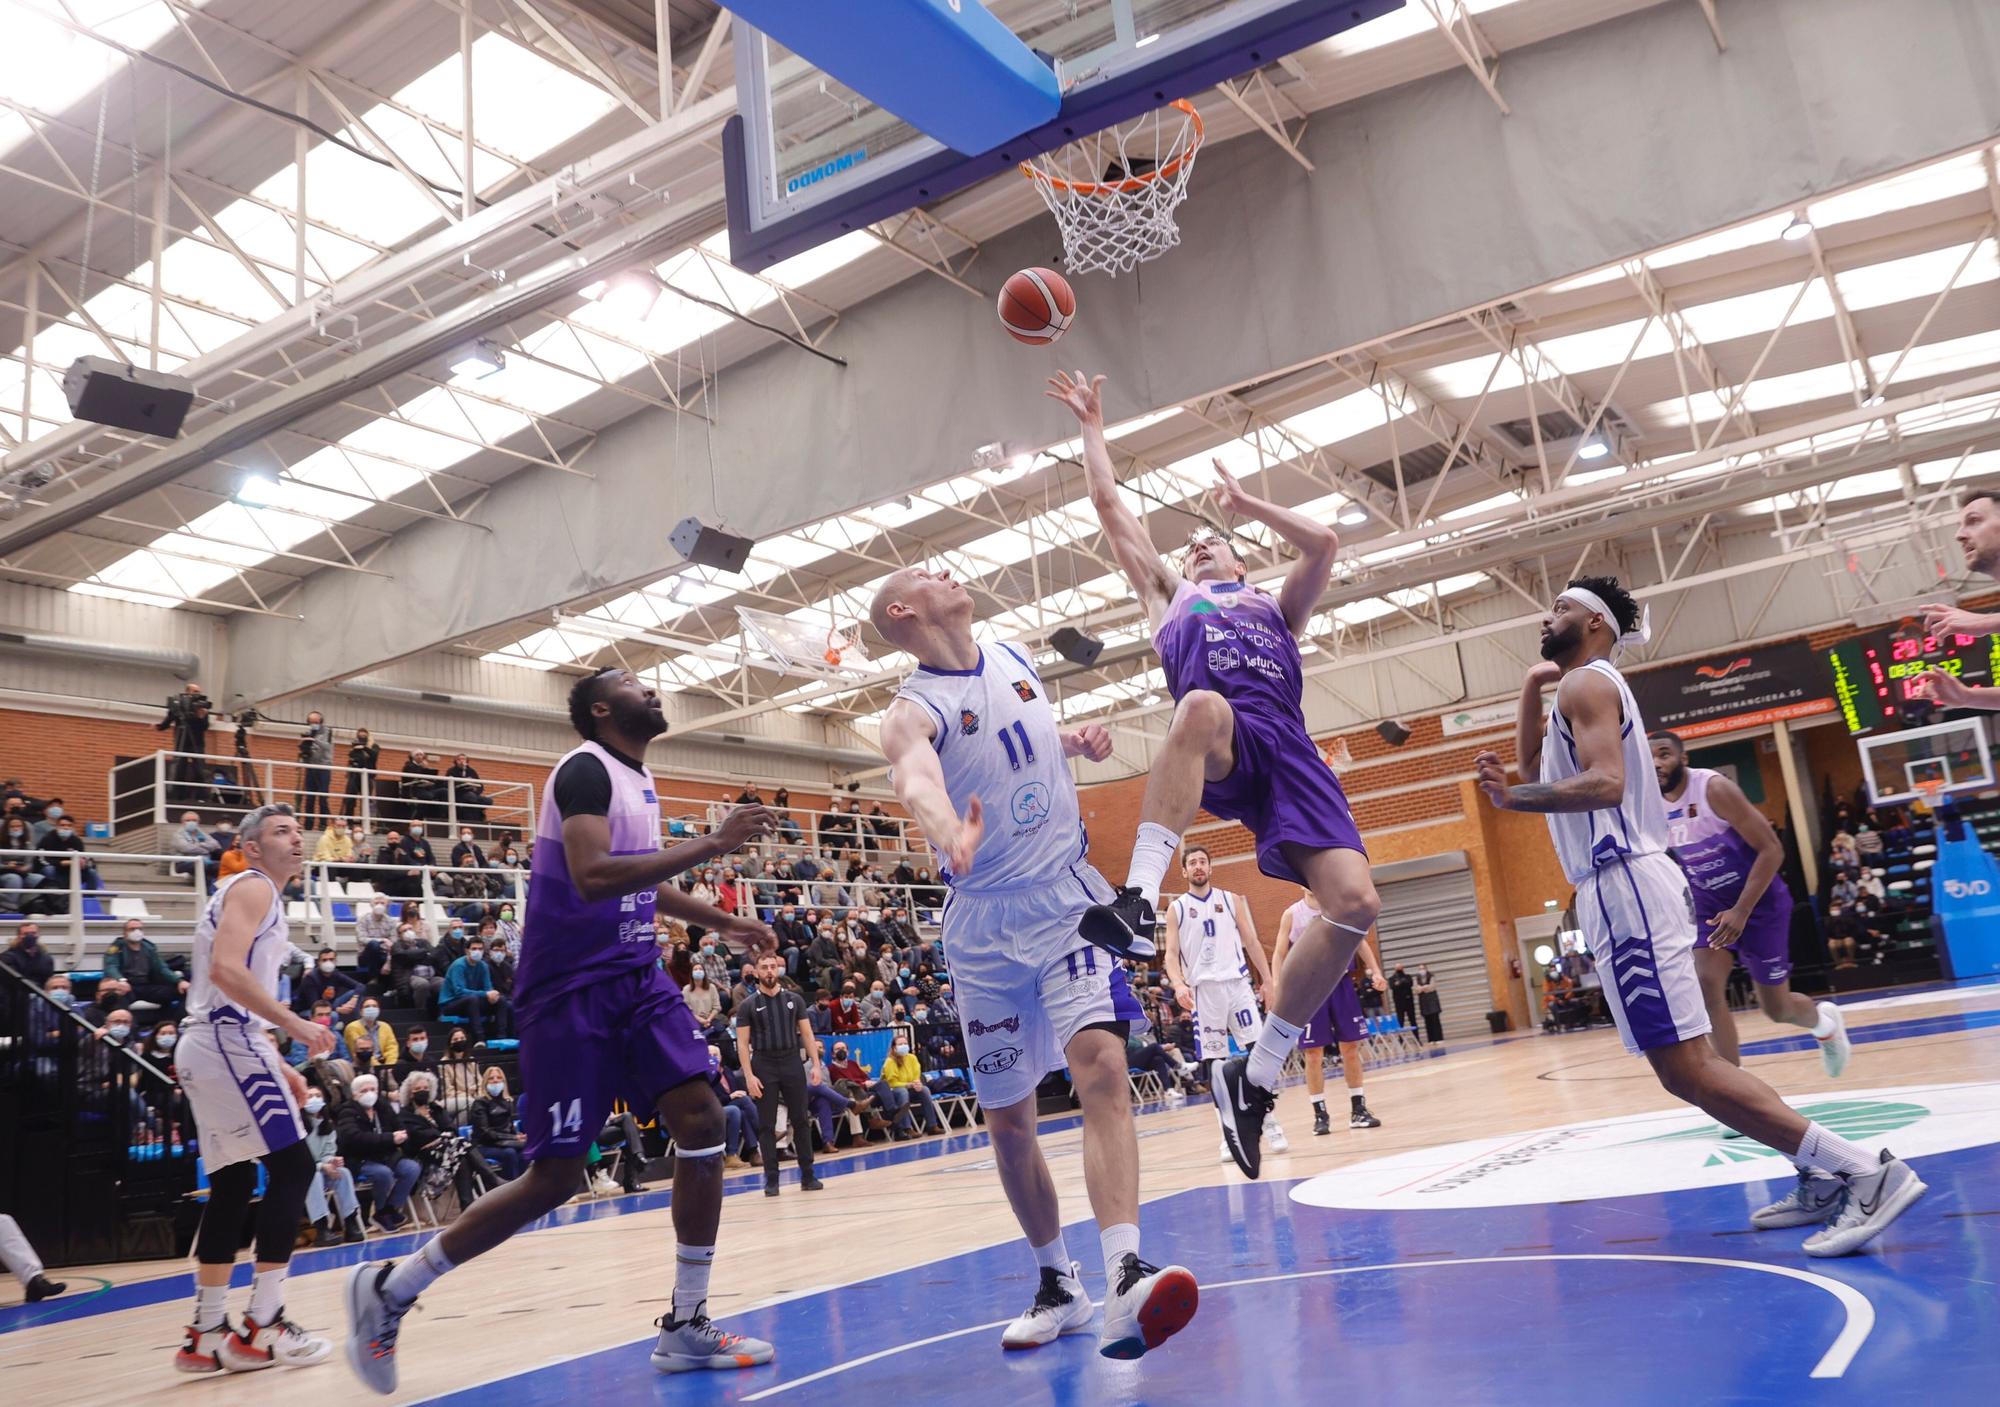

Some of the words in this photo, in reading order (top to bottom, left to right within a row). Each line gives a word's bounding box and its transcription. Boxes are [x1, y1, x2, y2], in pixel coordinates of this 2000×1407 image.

[998, 720, 1034, 771] 11
[1203, 919, 1216, 938] 10
[1235, 1008, 1253, 1028] 10
[548, 1098, 584, 1137] 14
